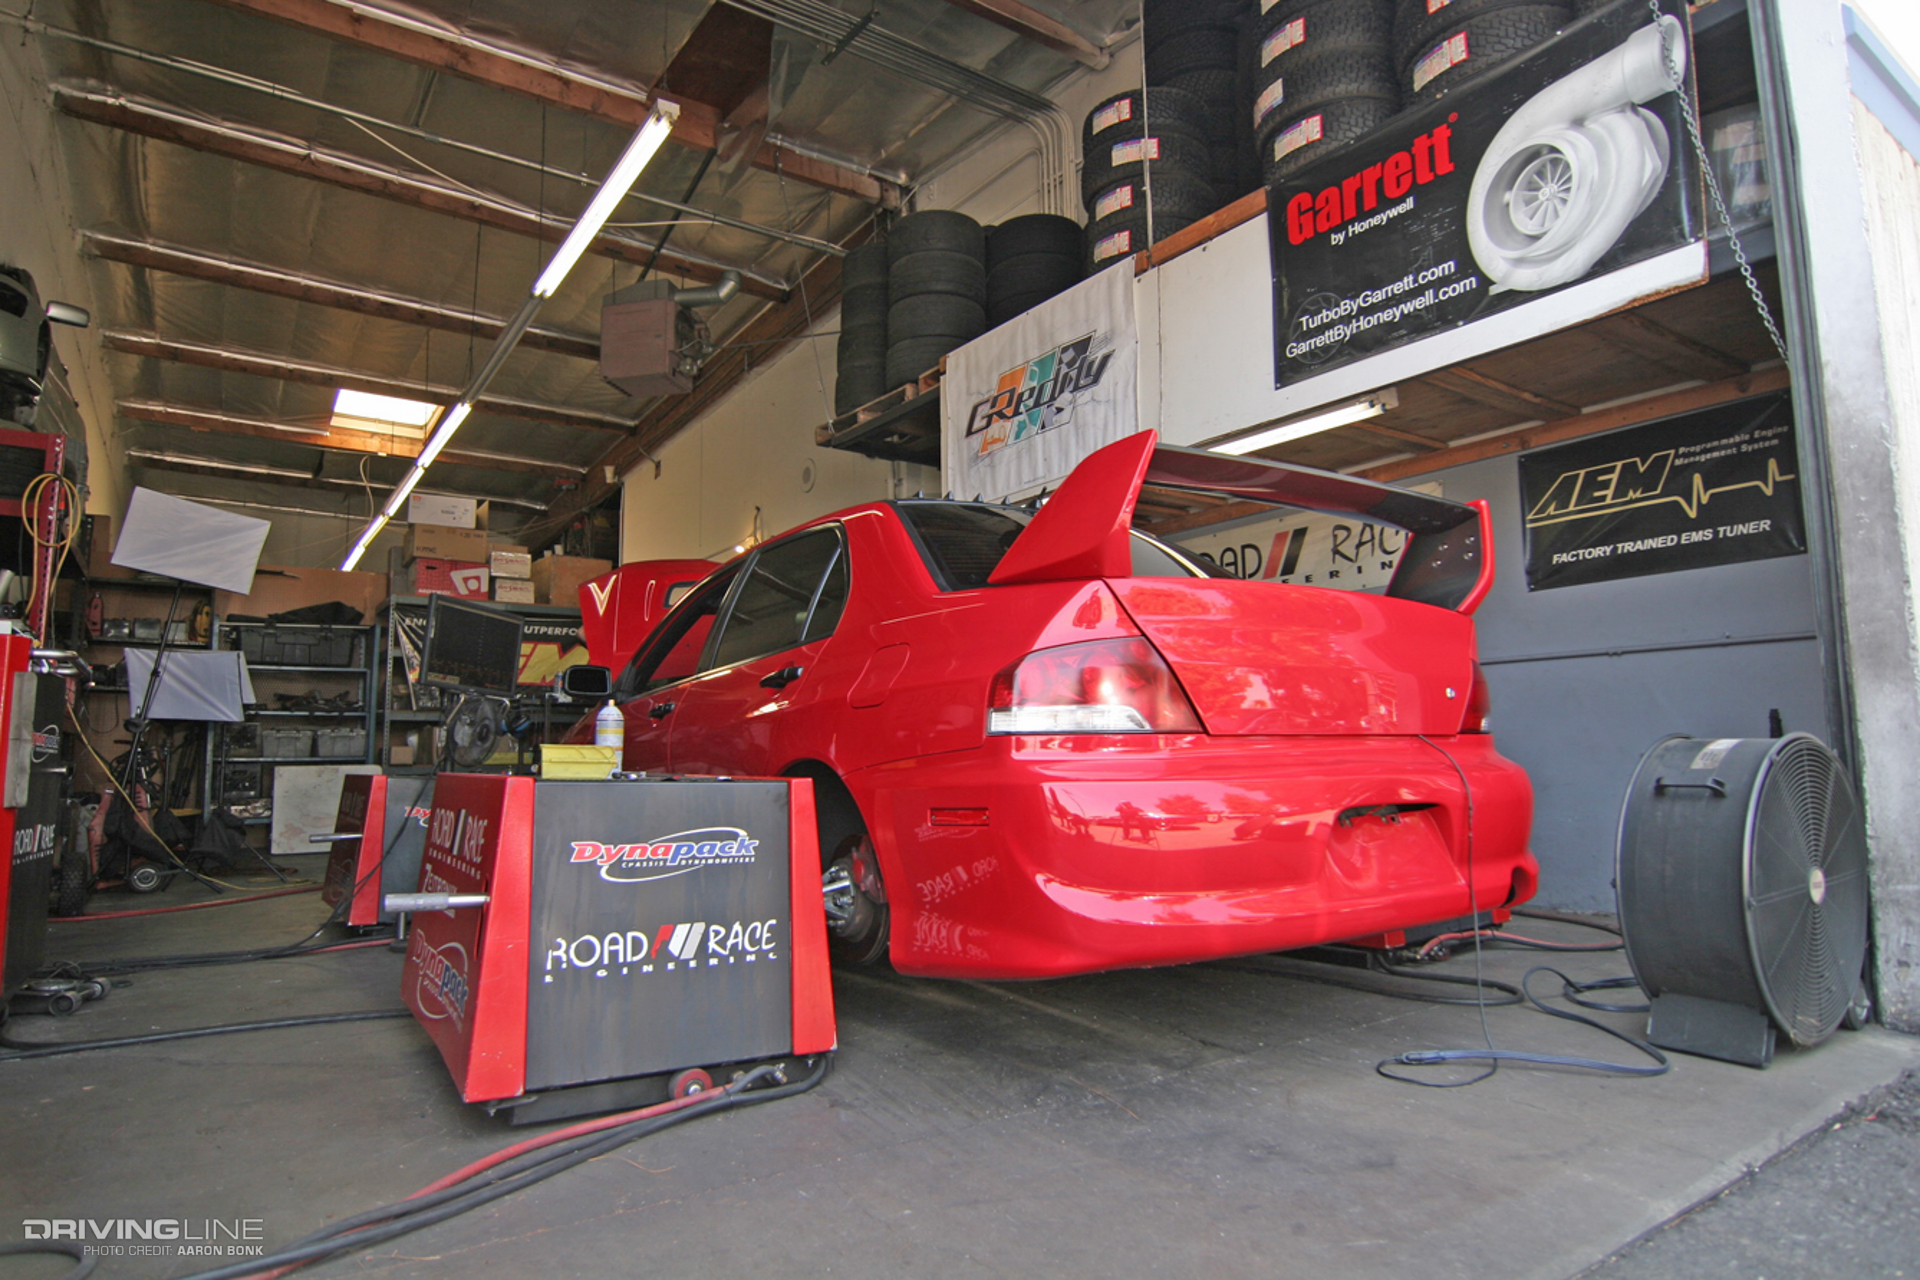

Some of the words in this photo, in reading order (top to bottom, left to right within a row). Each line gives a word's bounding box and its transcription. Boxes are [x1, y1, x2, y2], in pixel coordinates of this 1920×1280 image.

[1286, 123, 1456, 246] Garrett
[1330, 231, 1346, 246] by
[1347, 196, 1415, 238] Honeywell
[1286, 276, 1478, 359] GarrettByHoneywell.com
[1299, 260, 1457, 331] TurboByGarrett.com
[1674, 446, 1738, 466] Management
[1740, 438, 1780, 453] System
[1678, 433, 1751, 455] Programmable
[1753, 425, 1790, 439] Engine
[1526, 449, 1676, 520] AEM
[1552, 545, 1614, 565] FACTORY
[1616, 535, 1678, 554] TRAINED
[1680, 529, 1714, 545] EMS
[1717, 519, 1772, 538] TUNER
[431, 808, 455, 849] ROAD
[463, 815, 488, 864] RACE
[570, 836, 760, 867] Dynapack
[621, 860, 664, 869] CHASSIS
[679, 857, 756, 867] DYNAMOMETERS
[546, 931, 649, 971] ROAD
[707, 919, 778, 956] RACE
